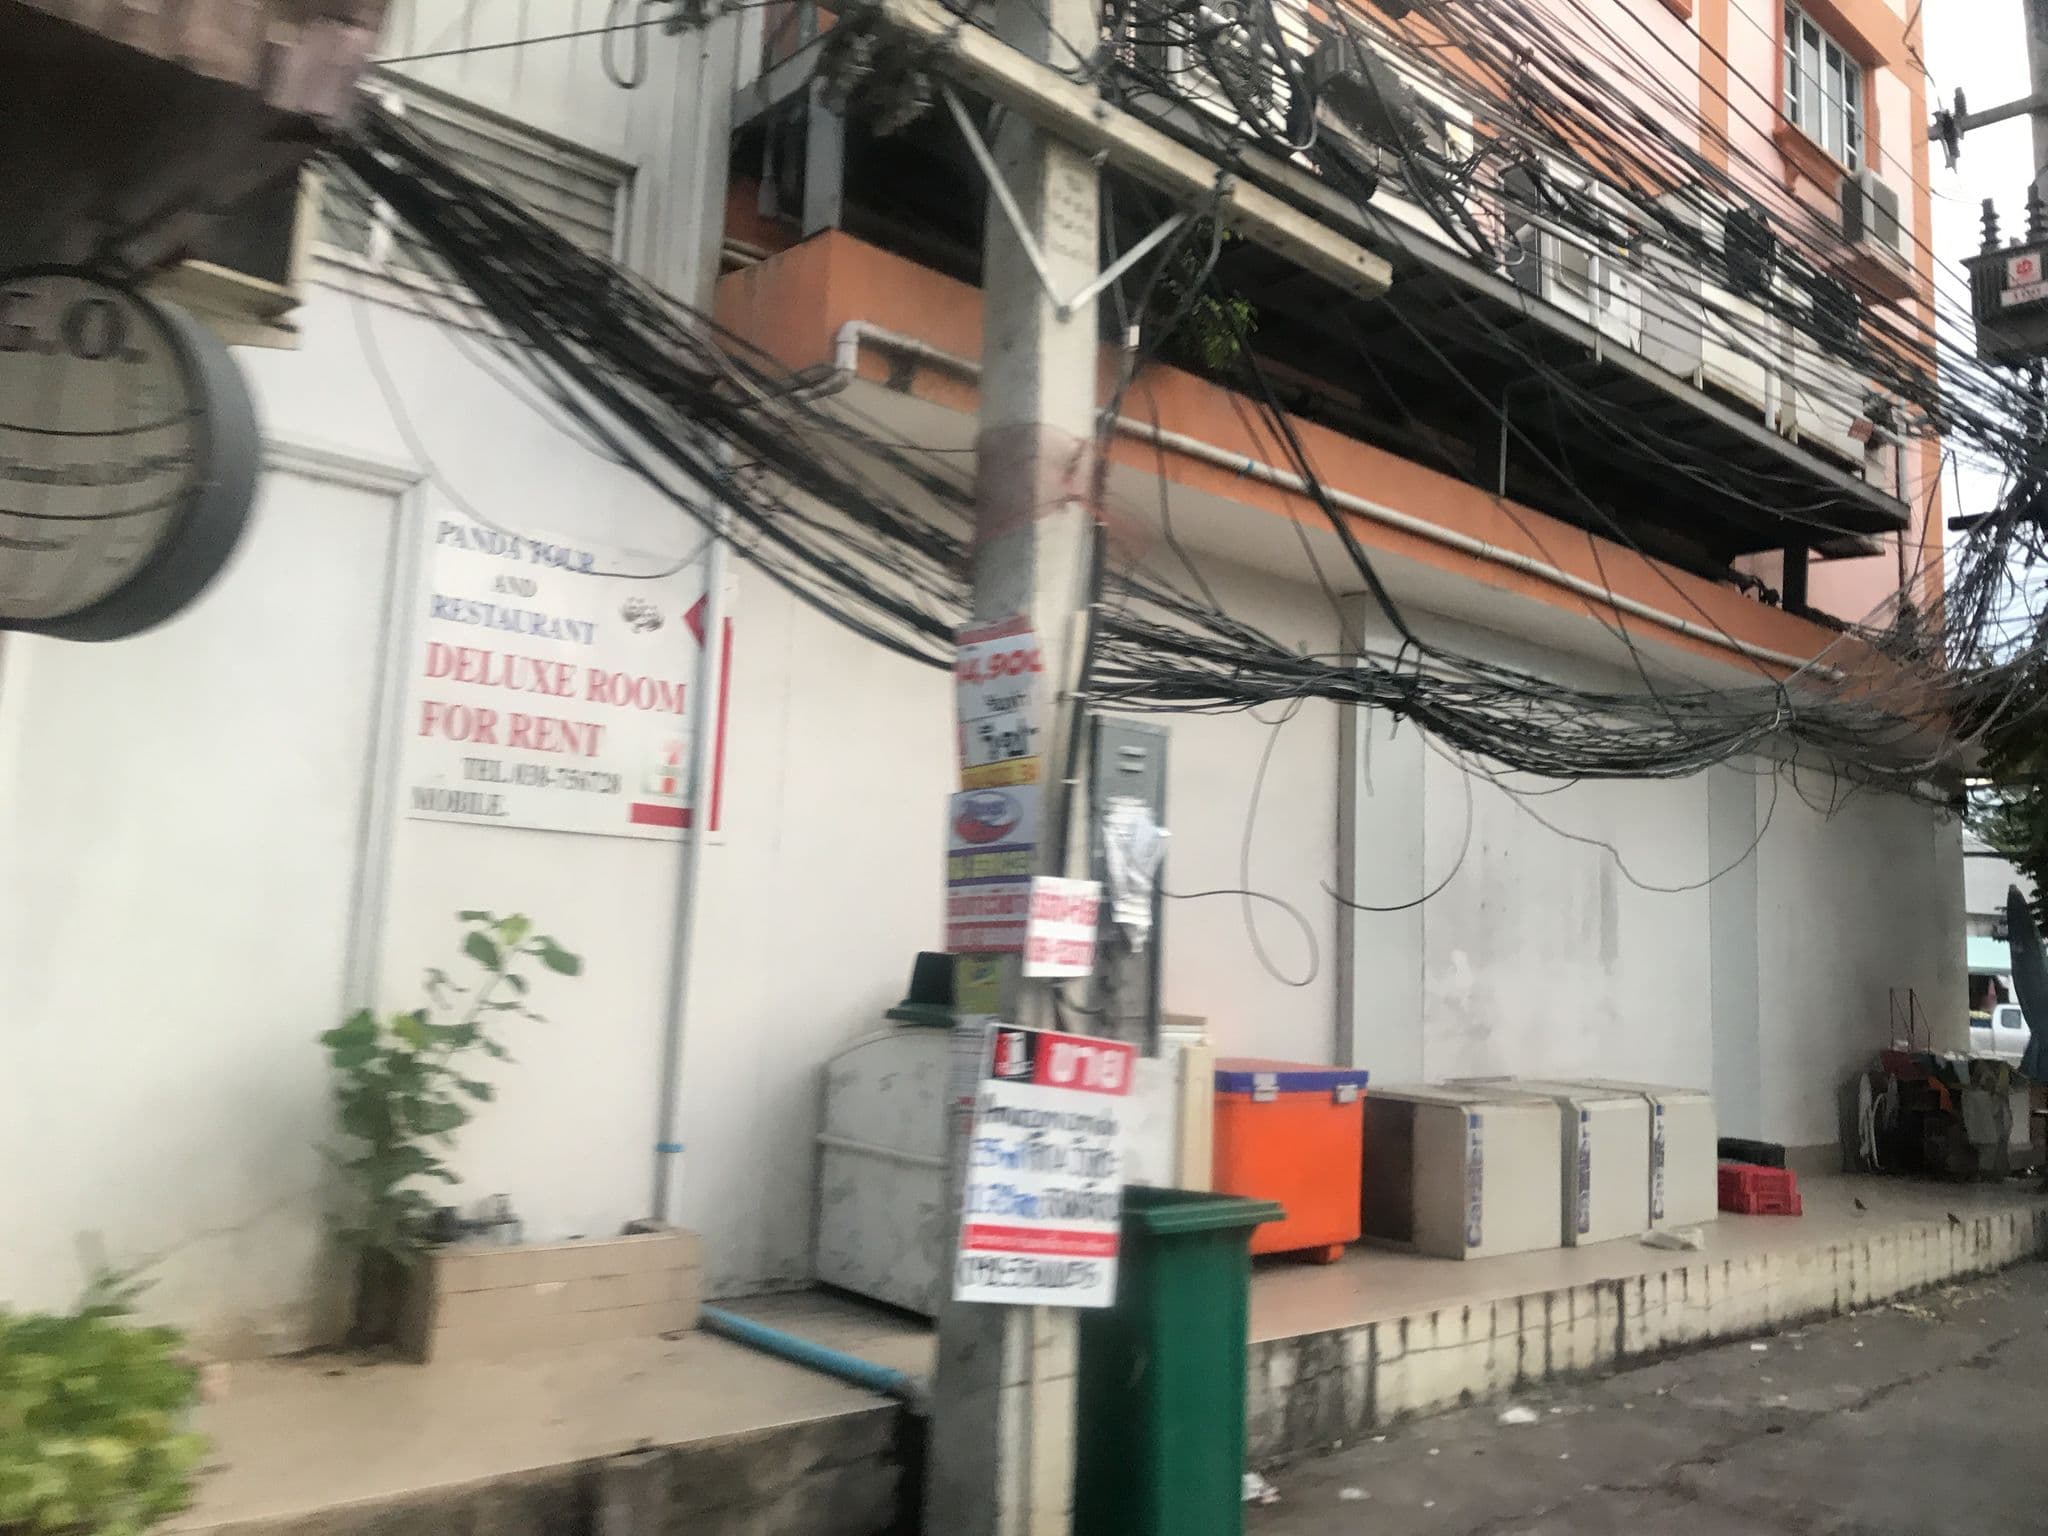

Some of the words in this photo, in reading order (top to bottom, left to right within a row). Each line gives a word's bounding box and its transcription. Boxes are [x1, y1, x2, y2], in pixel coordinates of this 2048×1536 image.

[435, 520, 521, 561] PANDA
[430, 594, 598, 645] RESTAURANT
[424, 641, 577, 698] DELUXE
[585, 667, 687, 715] ROOM
[418, 700, 498, 744] FOR
[506, 712, 607, 757] RENT
